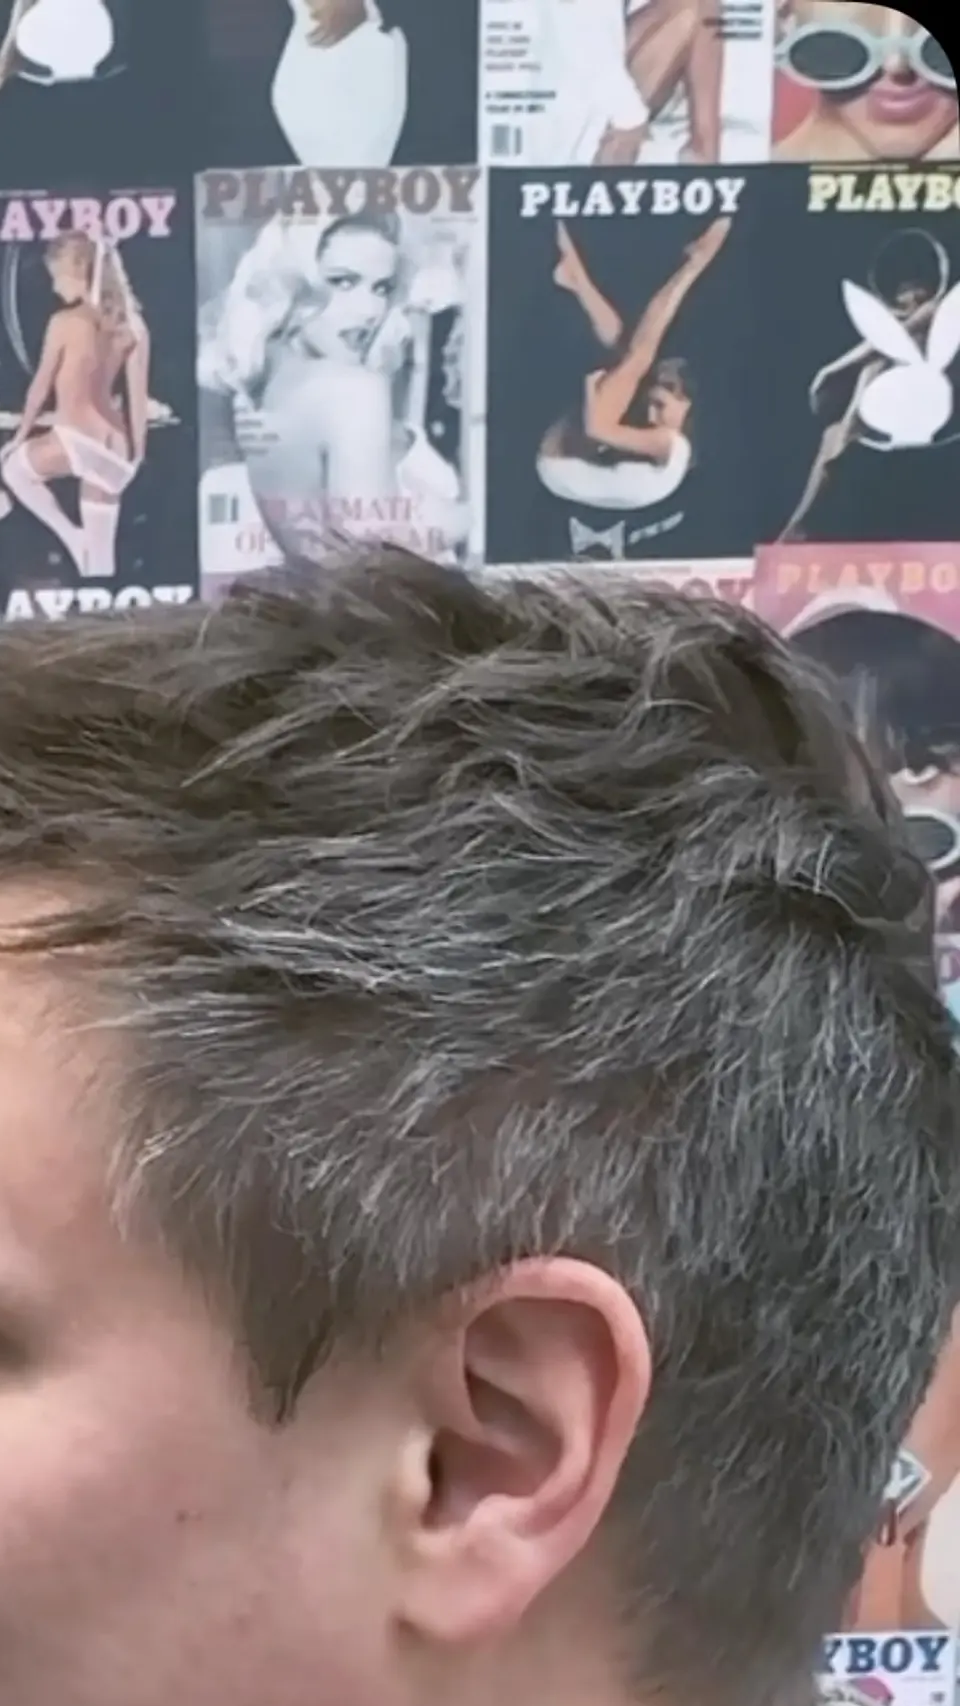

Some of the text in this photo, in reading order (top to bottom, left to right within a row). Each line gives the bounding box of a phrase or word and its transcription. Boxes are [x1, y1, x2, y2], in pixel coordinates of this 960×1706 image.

[199, 167, 481, 219] PLAYBOY
[520, 177, 746, 217] PLAYBOY
[807, 173, 960, 212] PLAYB
